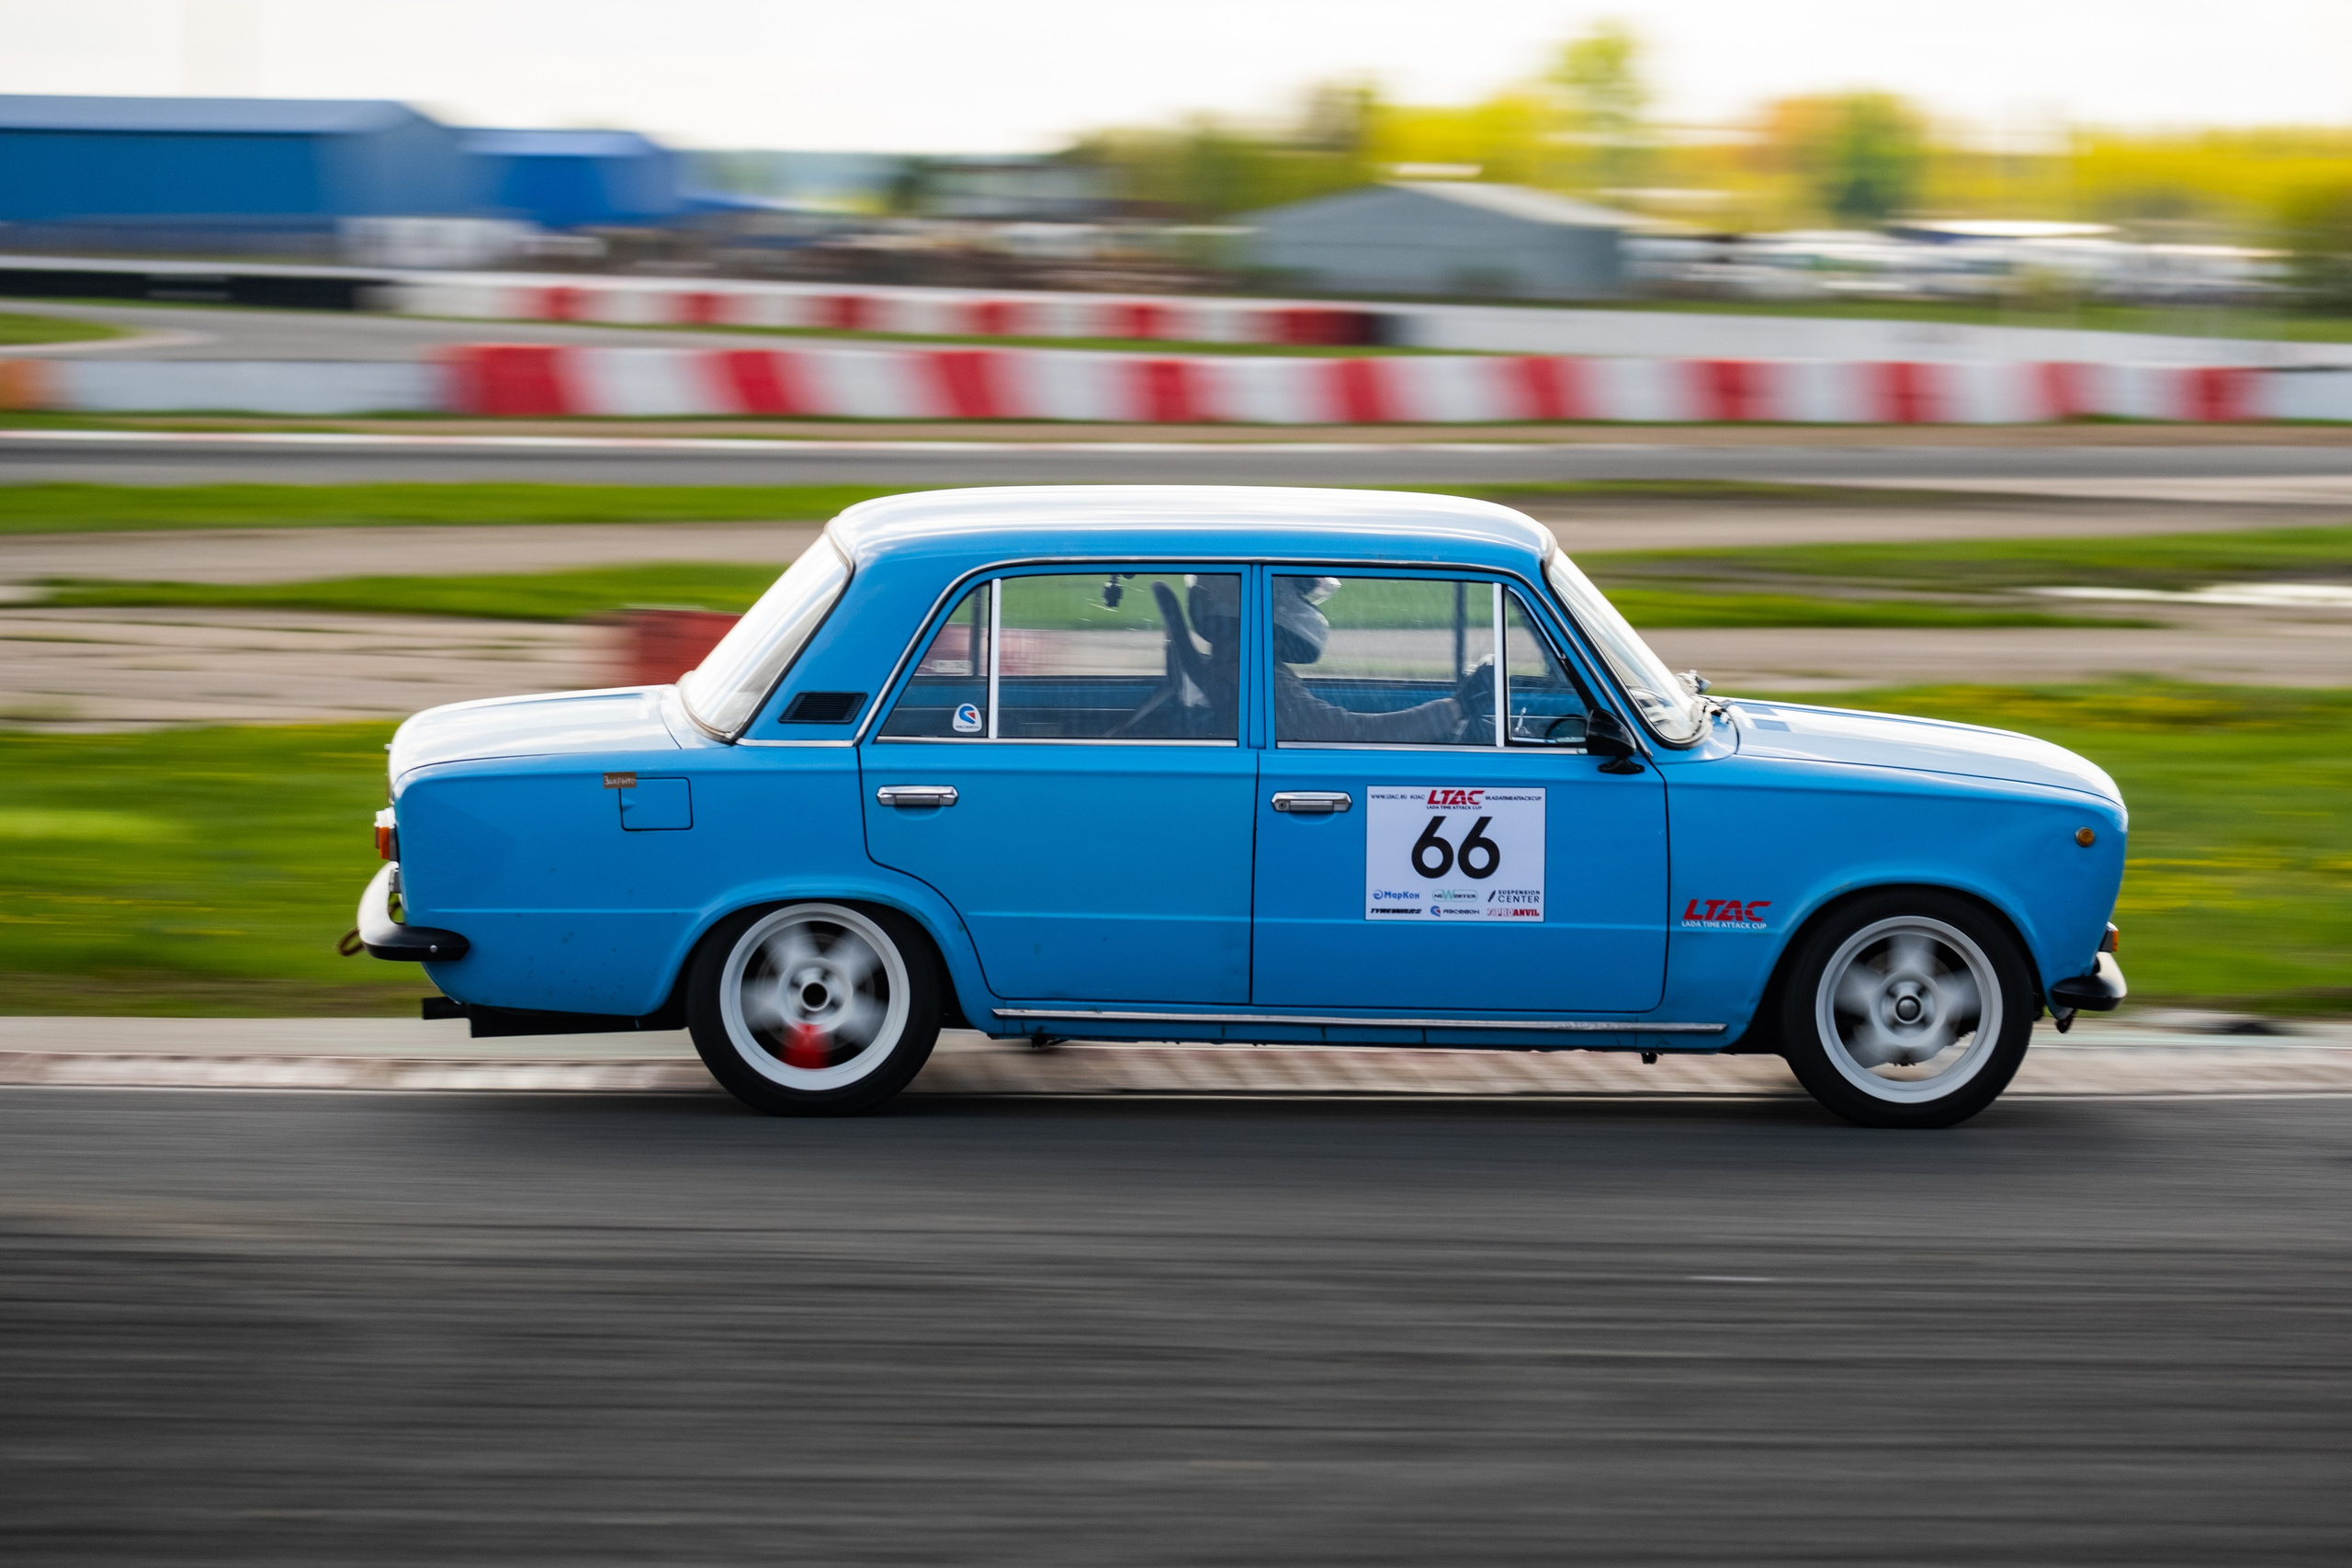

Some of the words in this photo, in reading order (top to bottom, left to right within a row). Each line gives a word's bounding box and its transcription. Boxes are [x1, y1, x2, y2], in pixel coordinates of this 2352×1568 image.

[1427, 789, 1485, 805] LTAC
[1411, 815, 1500, 879] 66
[1498, 895, 1540, 904] CENTER
[1682, 898, 1772, 922] LTAC
